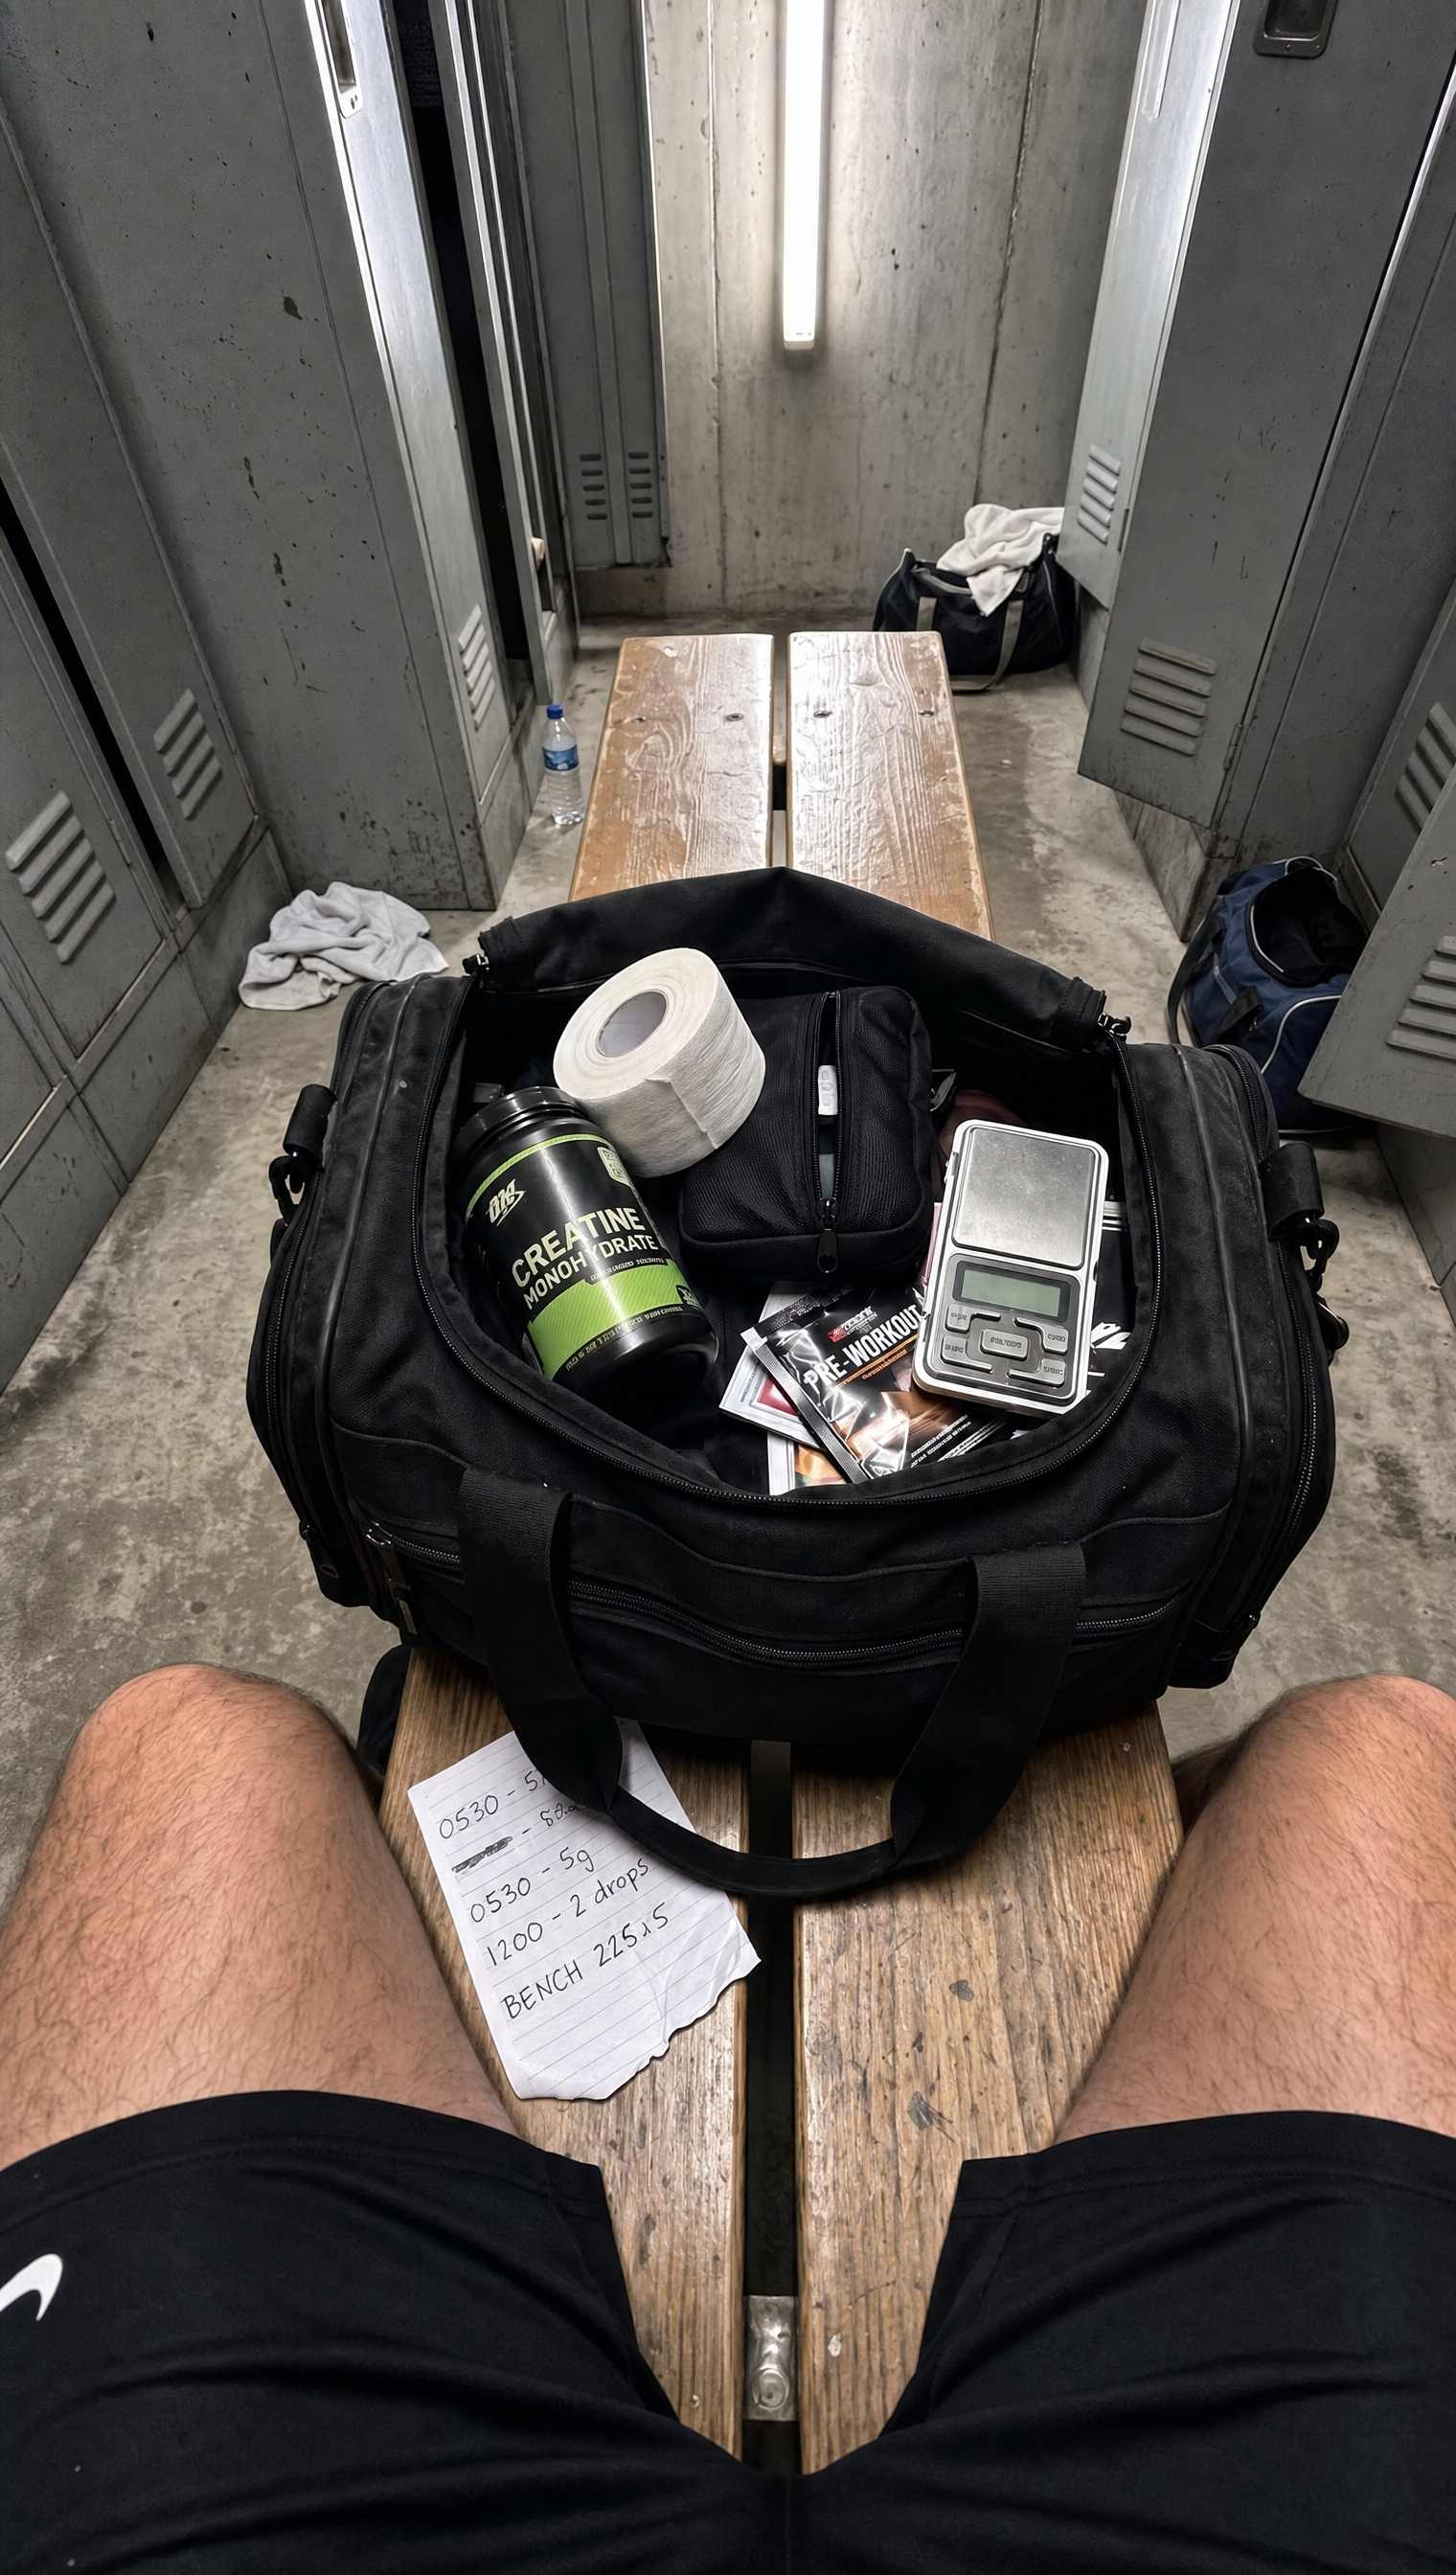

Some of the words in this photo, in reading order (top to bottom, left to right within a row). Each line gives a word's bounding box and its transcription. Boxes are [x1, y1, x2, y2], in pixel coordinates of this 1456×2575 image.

[512, 1208, 646, 1287] CREATINE
[523, 1234, 659, 1310] MONOHYDRATE
[804, 1304, 920, 1394] PRE-WORKOUT
[440, 1795, 498, 1838] 0530
[470, 1878, 531, 1923] 0530
[559, 1847, 595, 1873] 5g
[487, 1923, 542, 1966] 1200
[570, 1895, 587, 1917] 2
[594, 1858, 650, 1903] drops
[501, 1960, 583, 2018] BENCH
